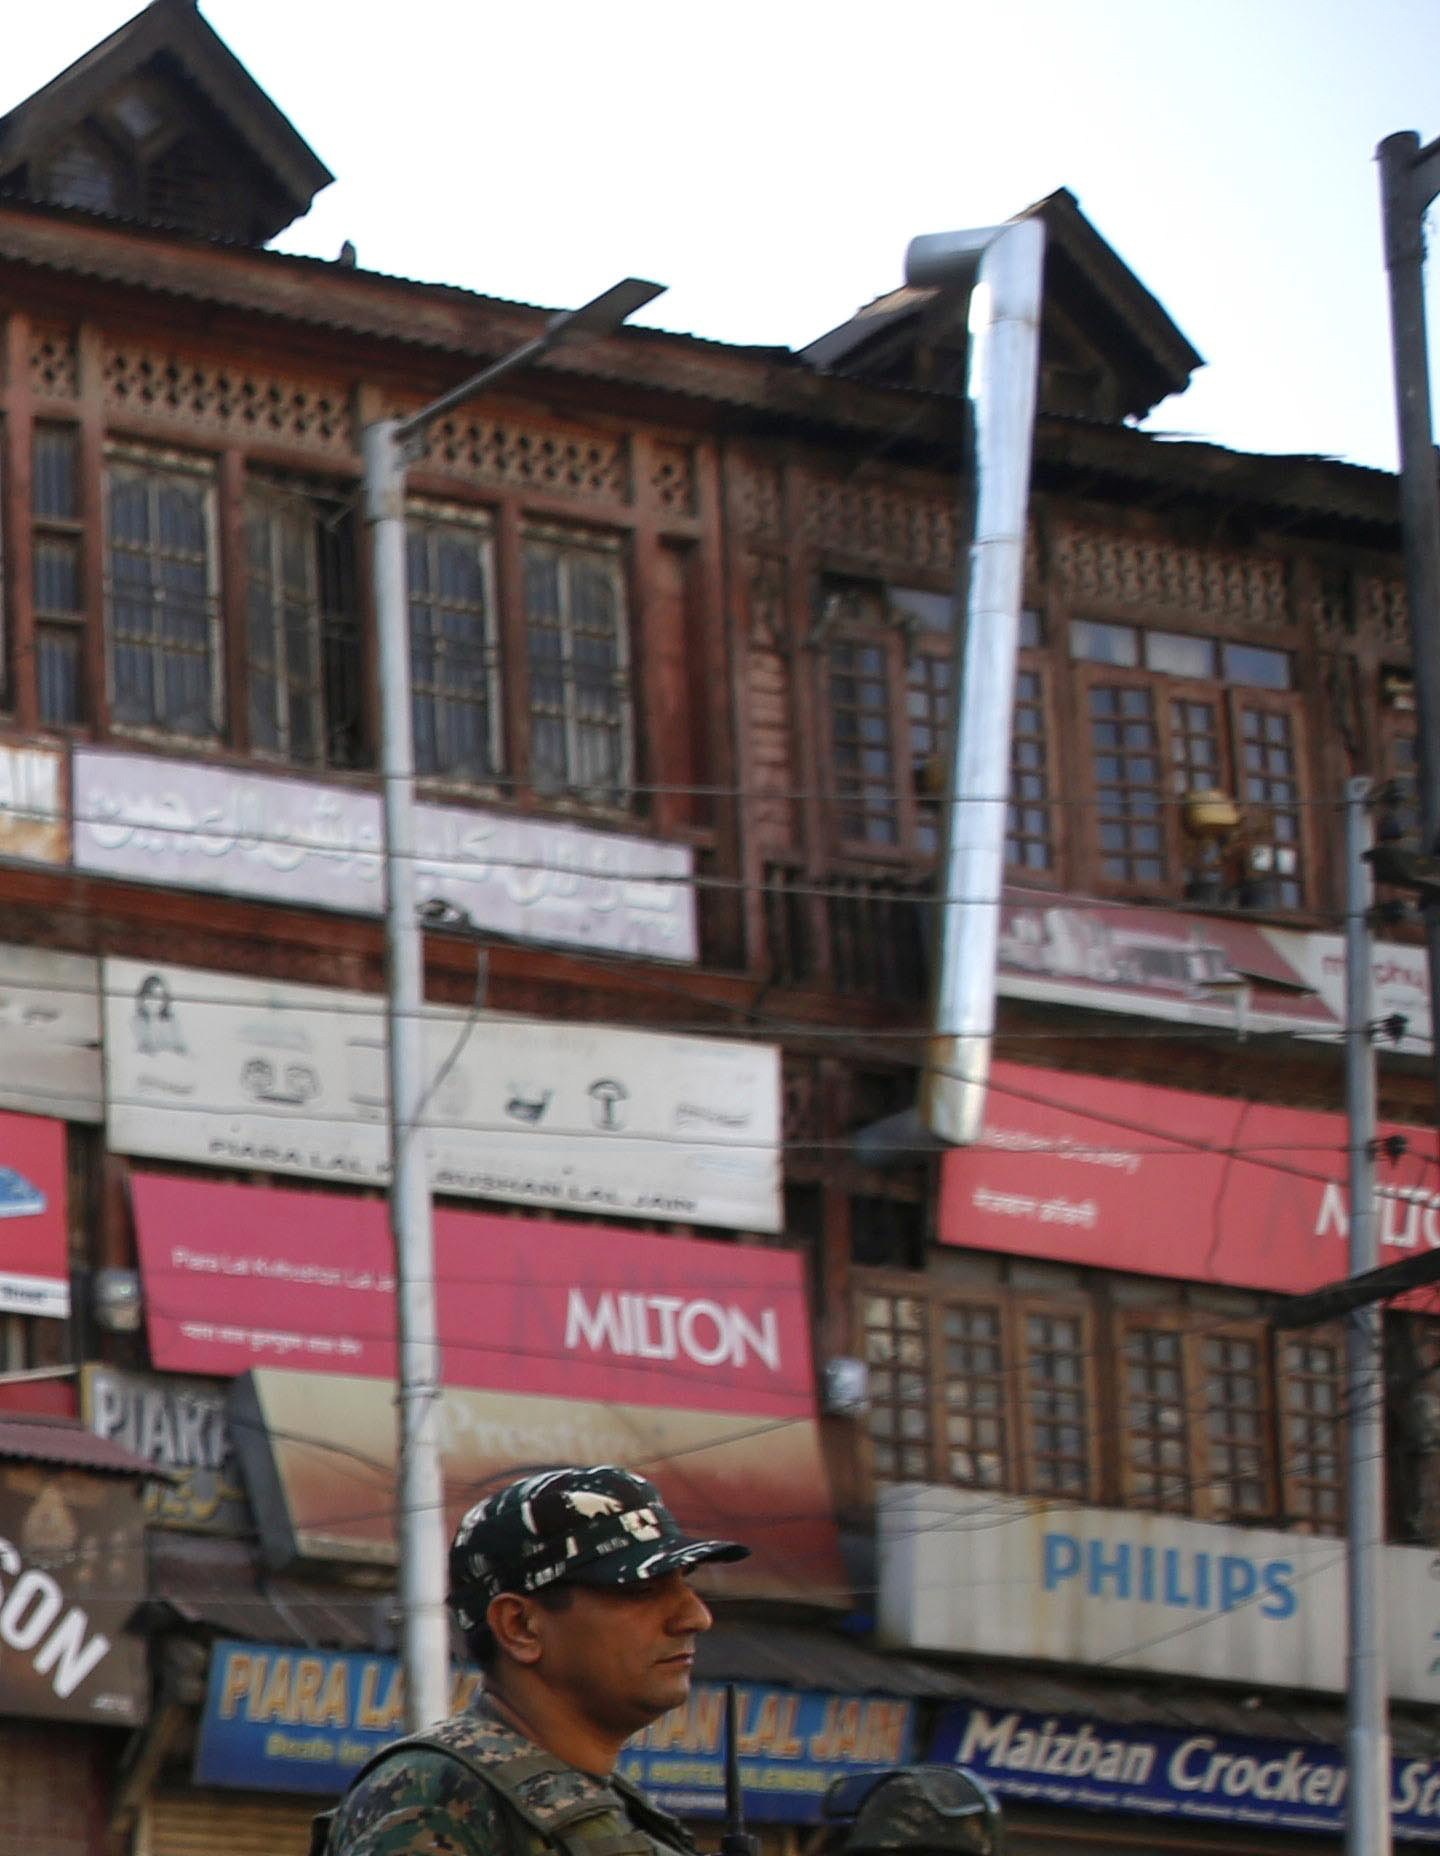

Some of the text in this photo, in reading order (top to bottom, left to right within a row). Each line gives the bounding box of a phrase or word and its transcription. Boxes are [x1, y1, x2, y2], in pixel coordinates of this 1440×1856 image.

[564, 1286, 778, 1369] MILTON
[1040, 1530, 1300, 1621] PHILIPS
[219, 1653, 350, 1729] PIARA
[355, 1659, 410, 1733] LA
[732, 1690, 803, 1760] LAL
[809, 1696, 909, 1765] JAIN
[956, 1709, 1157, 1786] Maizban
[1167, 1736, 1352, 1808] Crocker
